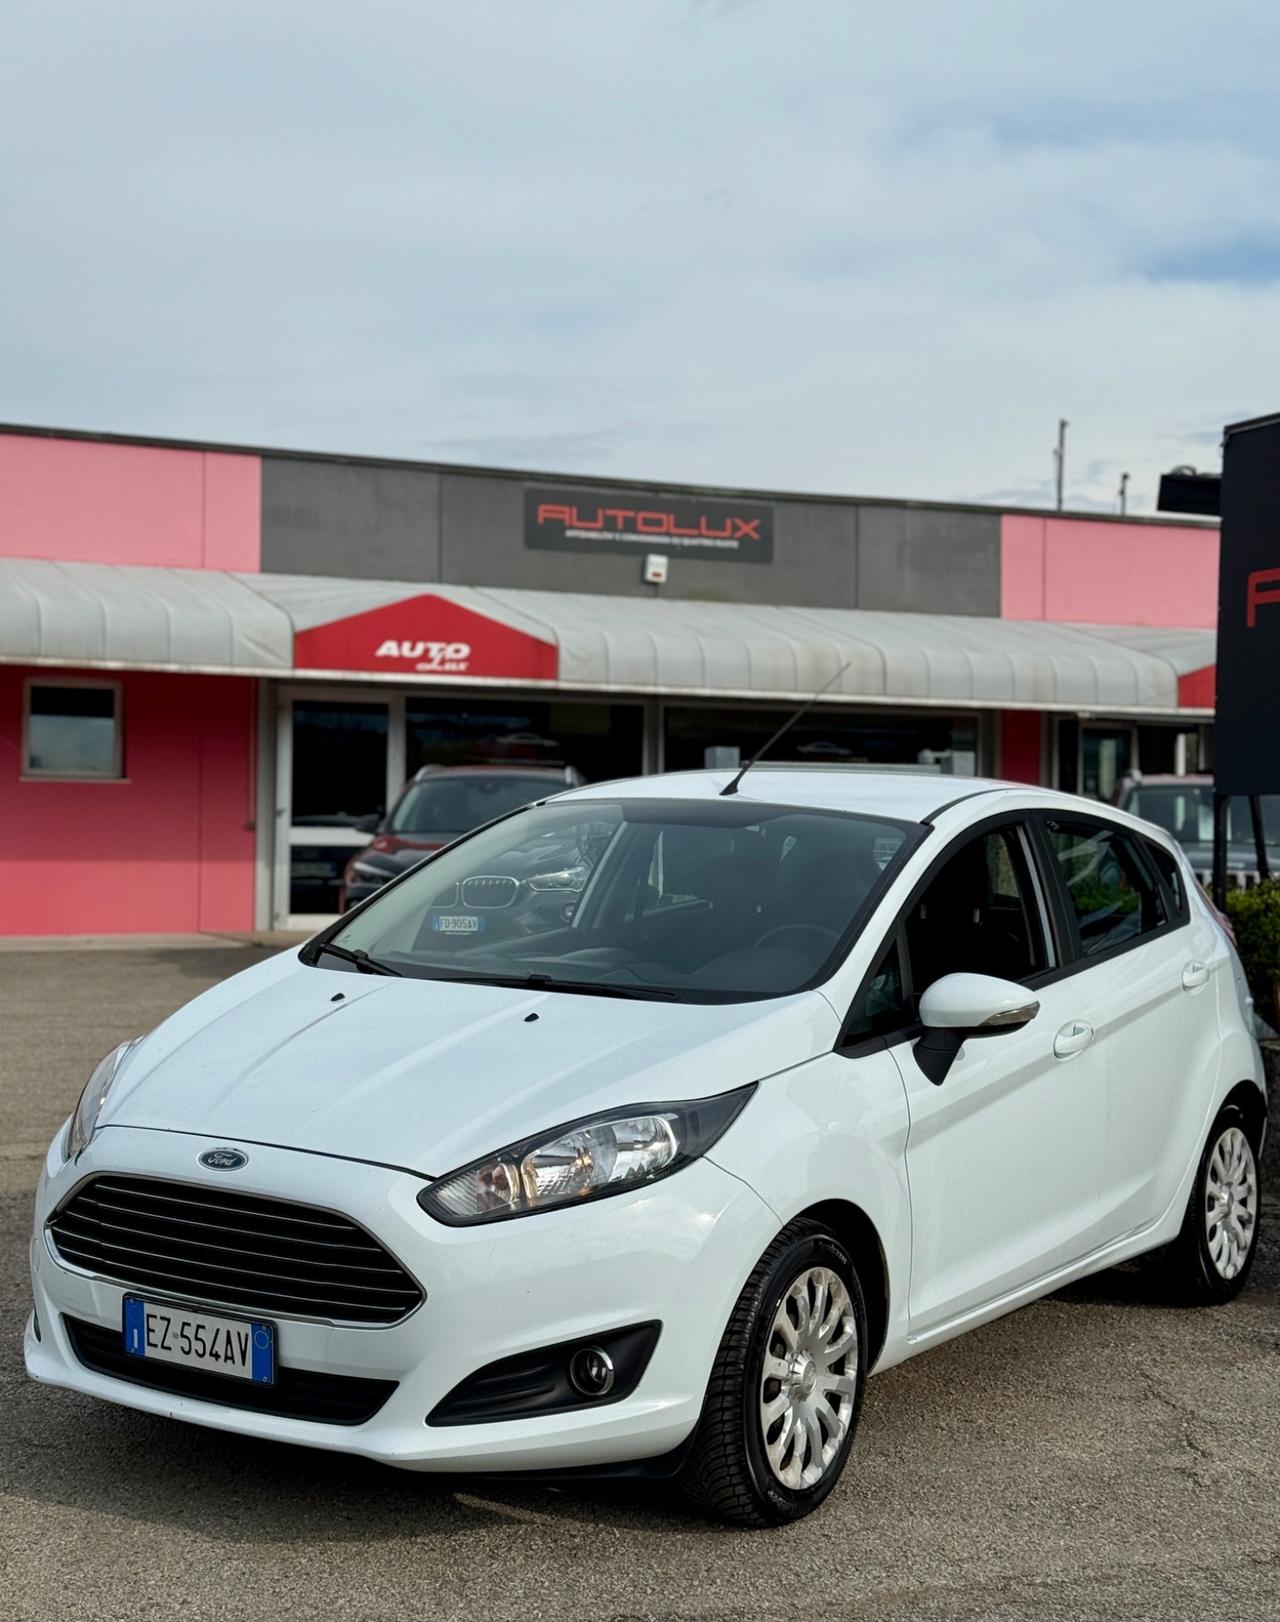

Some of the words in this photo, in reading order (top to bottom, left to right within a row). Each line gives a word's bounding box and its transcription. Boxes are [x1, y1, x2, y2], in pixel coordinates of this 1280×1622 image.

[537, 504, 761, 539] AUTOLUX
[375, 640, 472, 659] AUTO
[208, 1152, 238, 1166] Ford
